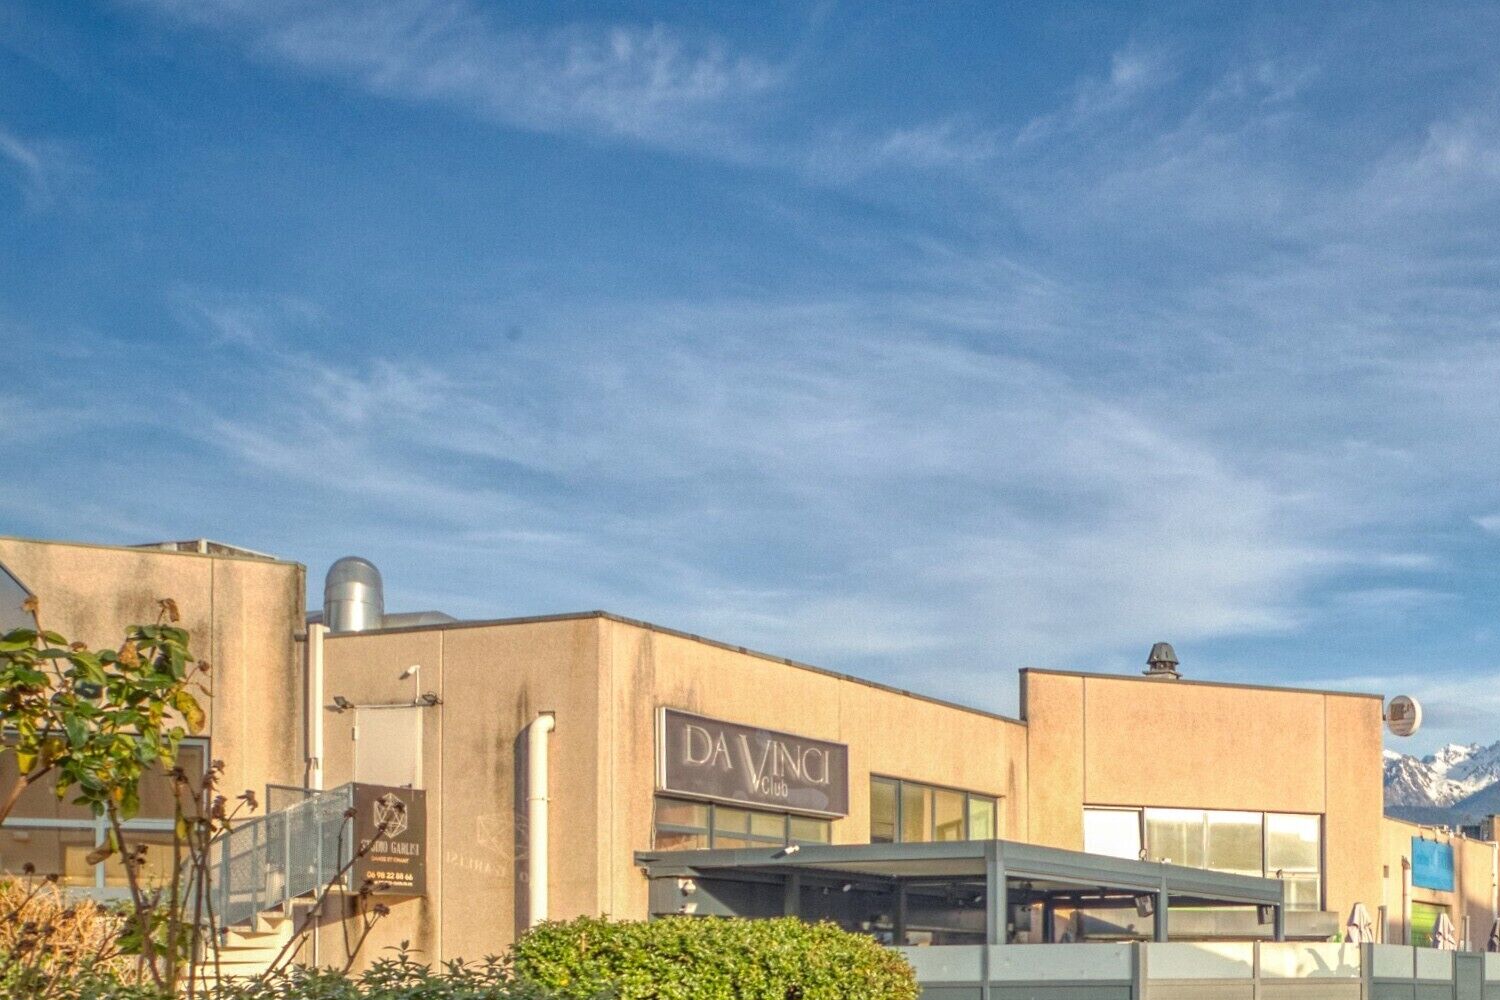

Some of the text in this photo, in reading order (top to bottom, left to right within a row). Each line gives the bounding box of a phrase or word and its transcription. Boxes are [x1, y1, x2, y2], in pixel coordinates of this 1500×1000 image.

[686, 724, 831, 793] DA VINCI
[761, 776, 788, 797] Club
[386, 872, 395, 880] 22
